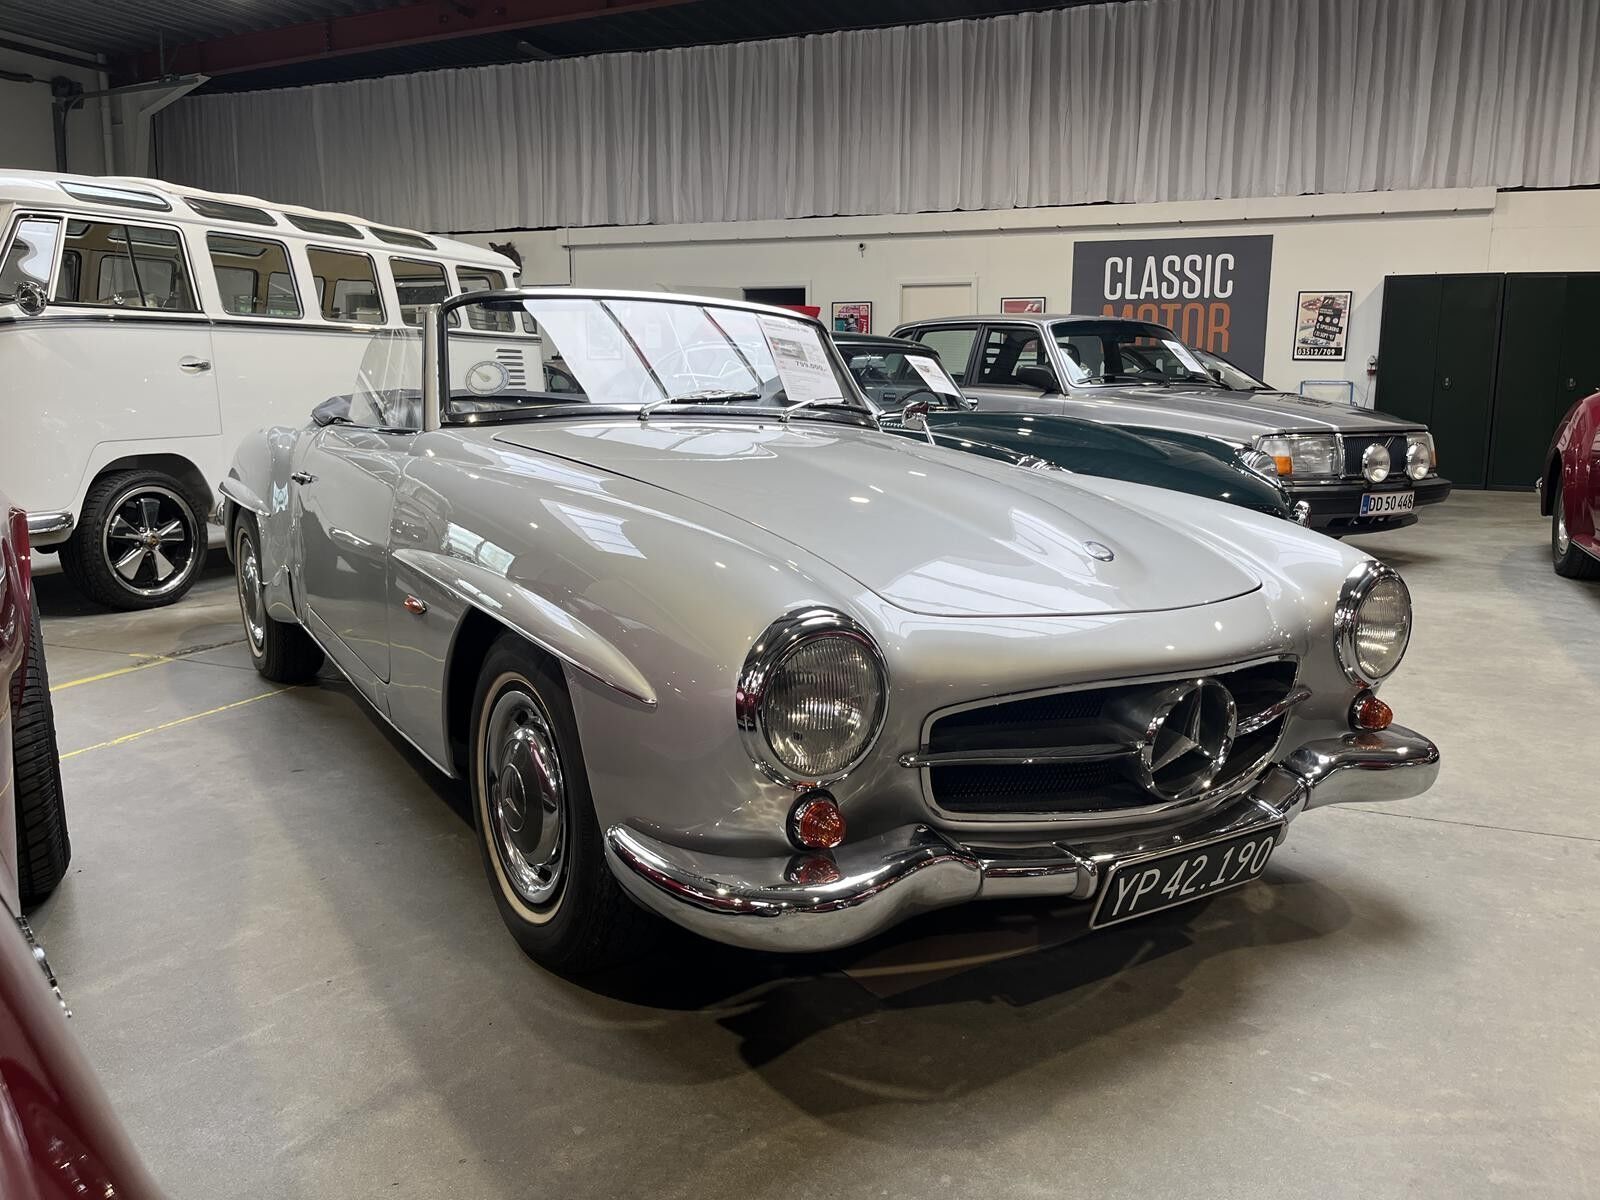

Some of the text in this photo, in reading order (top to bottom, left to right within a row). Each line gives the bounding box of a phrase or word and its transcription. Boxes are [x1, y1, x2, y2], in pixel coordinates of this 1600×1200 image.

[1103, 253, 1235, 301] CLASSIC
[1369, 497, 1383, 511] DD
[1385, 496, 1397, 511] 50
[1398, 494, 1413, 510] 448
[1111, 836, 1274, 917] YP 42.190
